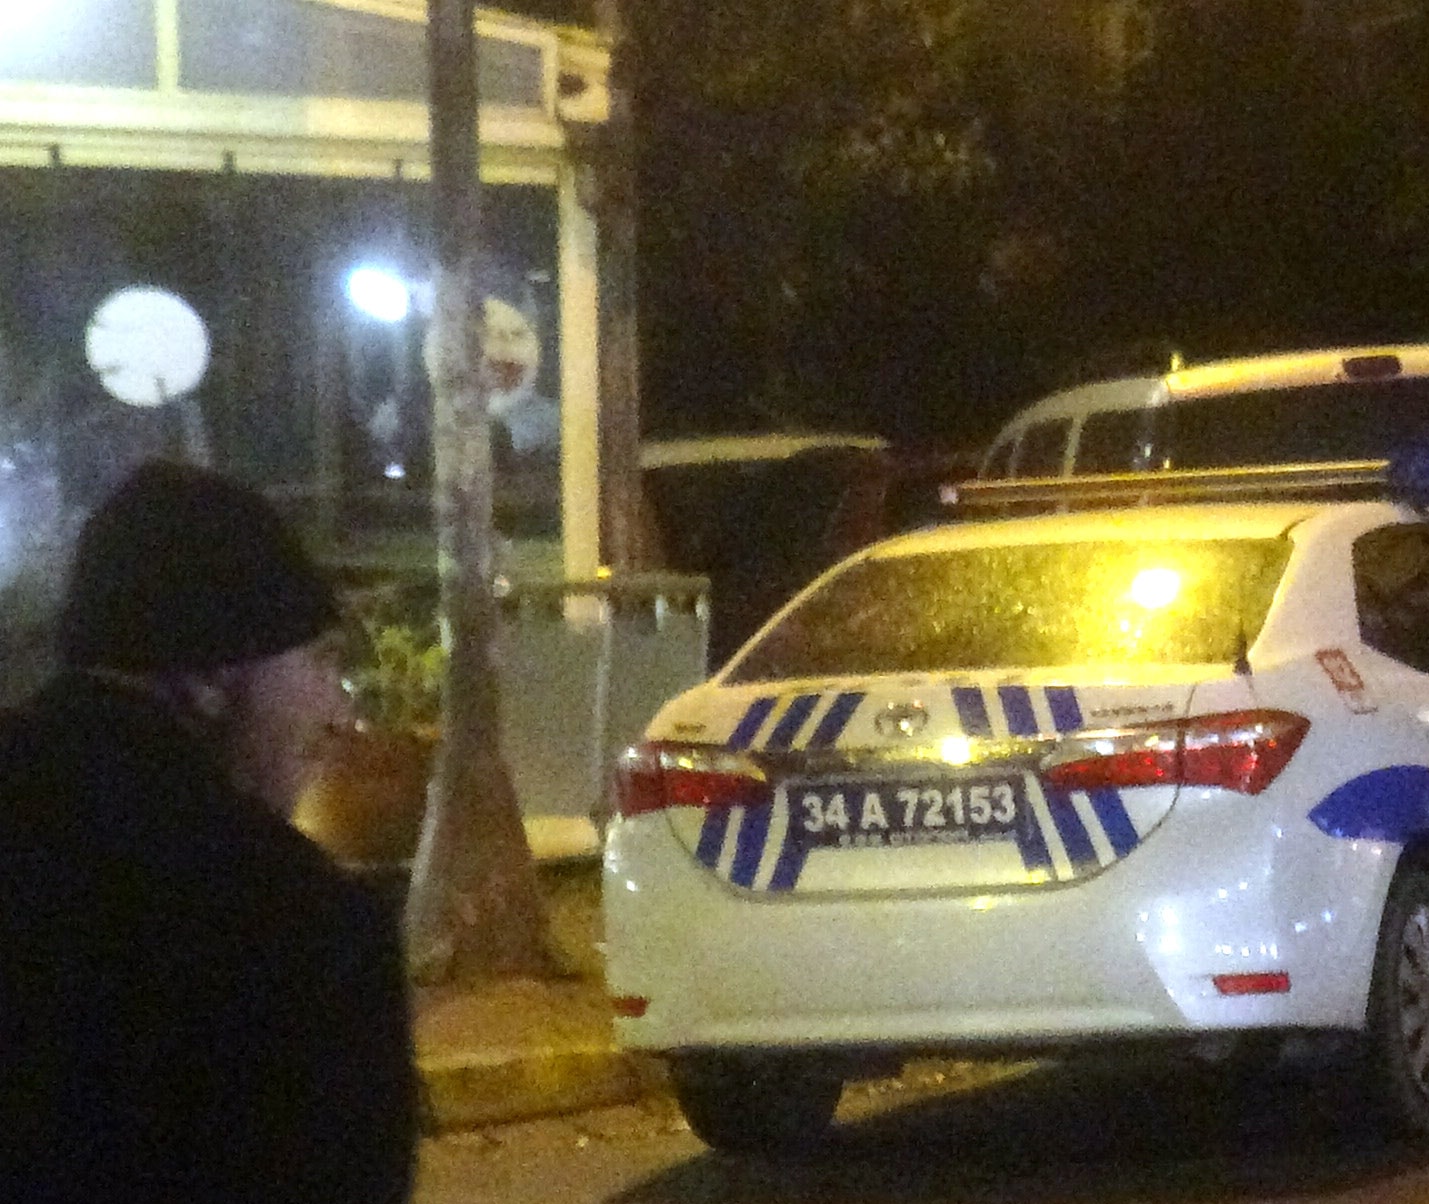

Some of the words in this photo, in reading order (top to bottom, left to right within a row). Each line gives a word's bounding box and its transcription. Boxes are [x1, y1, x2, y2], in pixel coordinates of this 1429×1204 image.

[802, 793, 849, 832] 34
[861, 792, 889, 830] A
[896, 783, 1017, 827] 72153
